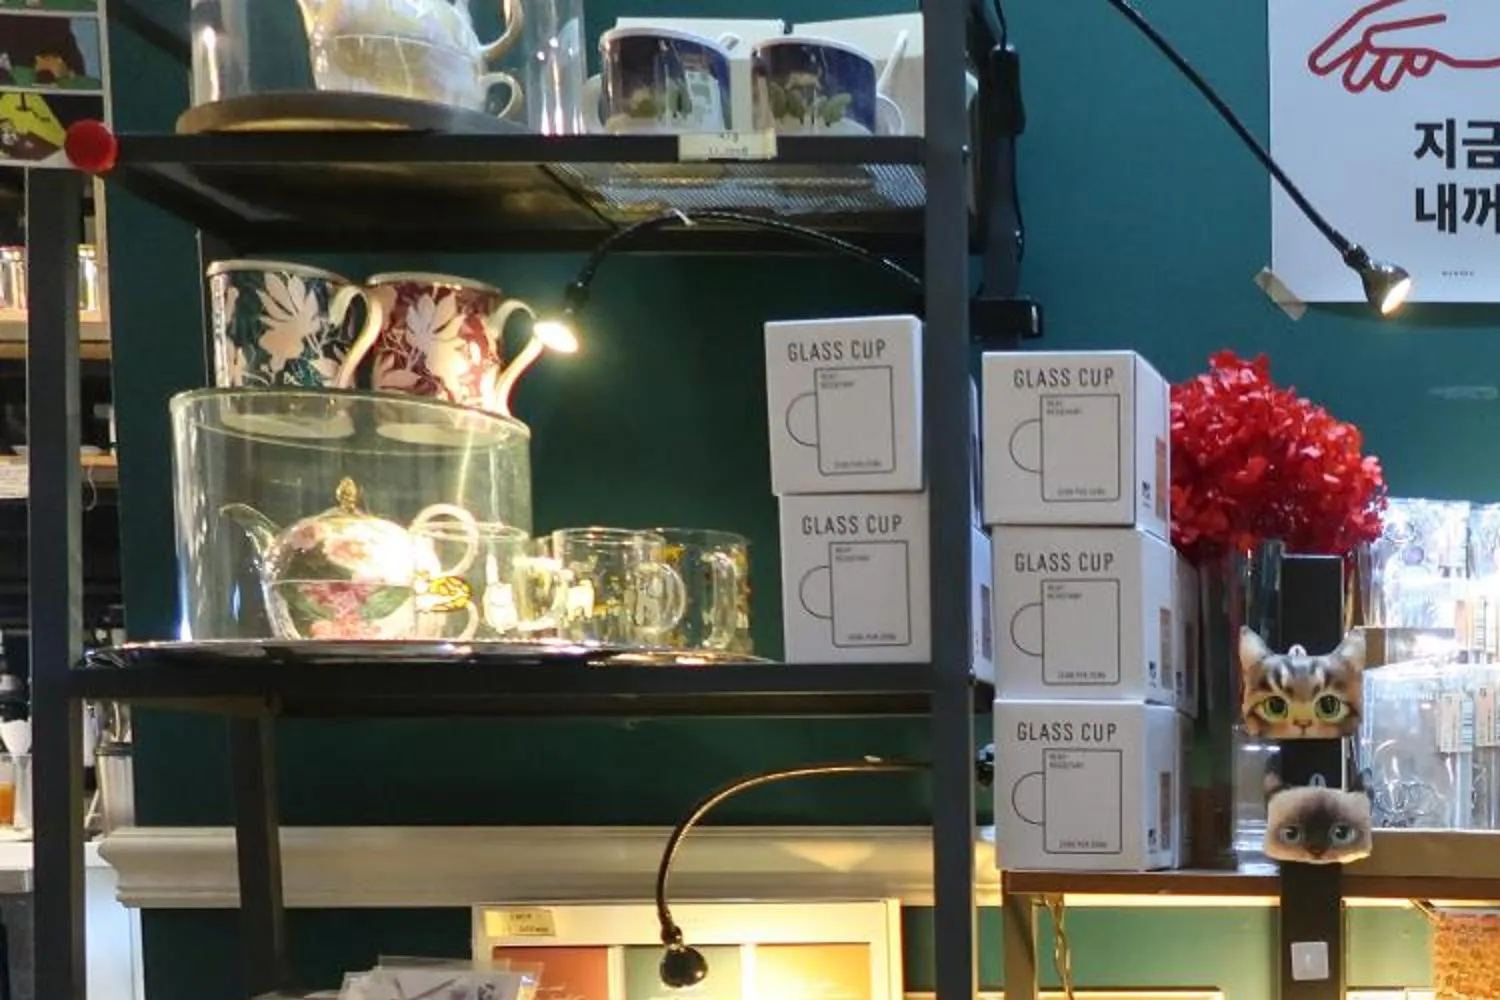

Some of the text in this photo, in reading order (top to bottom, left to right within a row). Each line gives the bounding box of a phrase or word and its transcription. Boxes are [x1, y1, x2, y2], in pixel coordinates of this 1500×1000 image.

[787, 338, 886, 362] GLASS CUP
[1013, 367, 1115, 388] GLASS CUP
[801, 514, 902, 535] GLASS CUP
[1014, 552, 1114, 573] GLASS CUP
[1017, 722, 1117, 742] GLASS CUP
